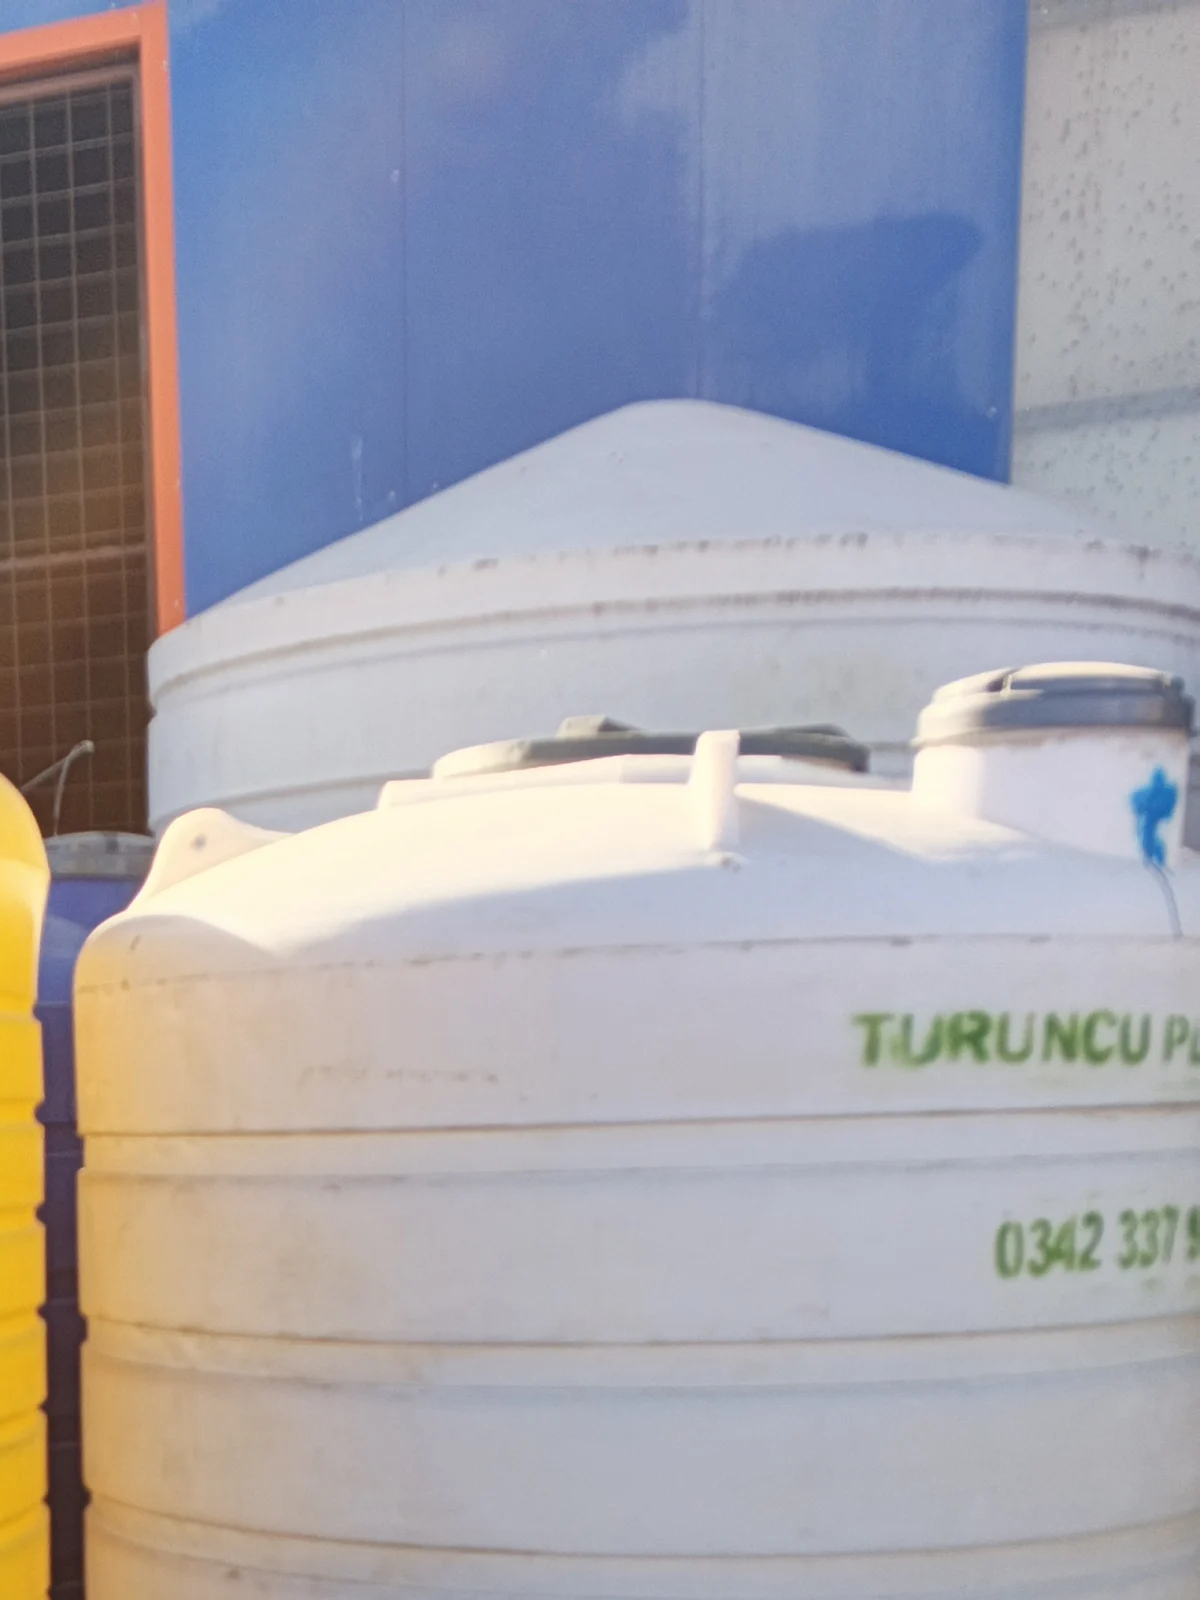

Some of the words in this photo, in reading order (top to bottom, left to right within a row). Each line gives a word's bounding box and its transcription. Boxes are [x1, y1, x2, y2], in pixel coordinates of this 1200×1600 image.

[852, 1010, 1152, 1067] TURUNCU
[995, 1211, 1104, 1279] 0342
[1117, 1205, 1180, 1270] 337
